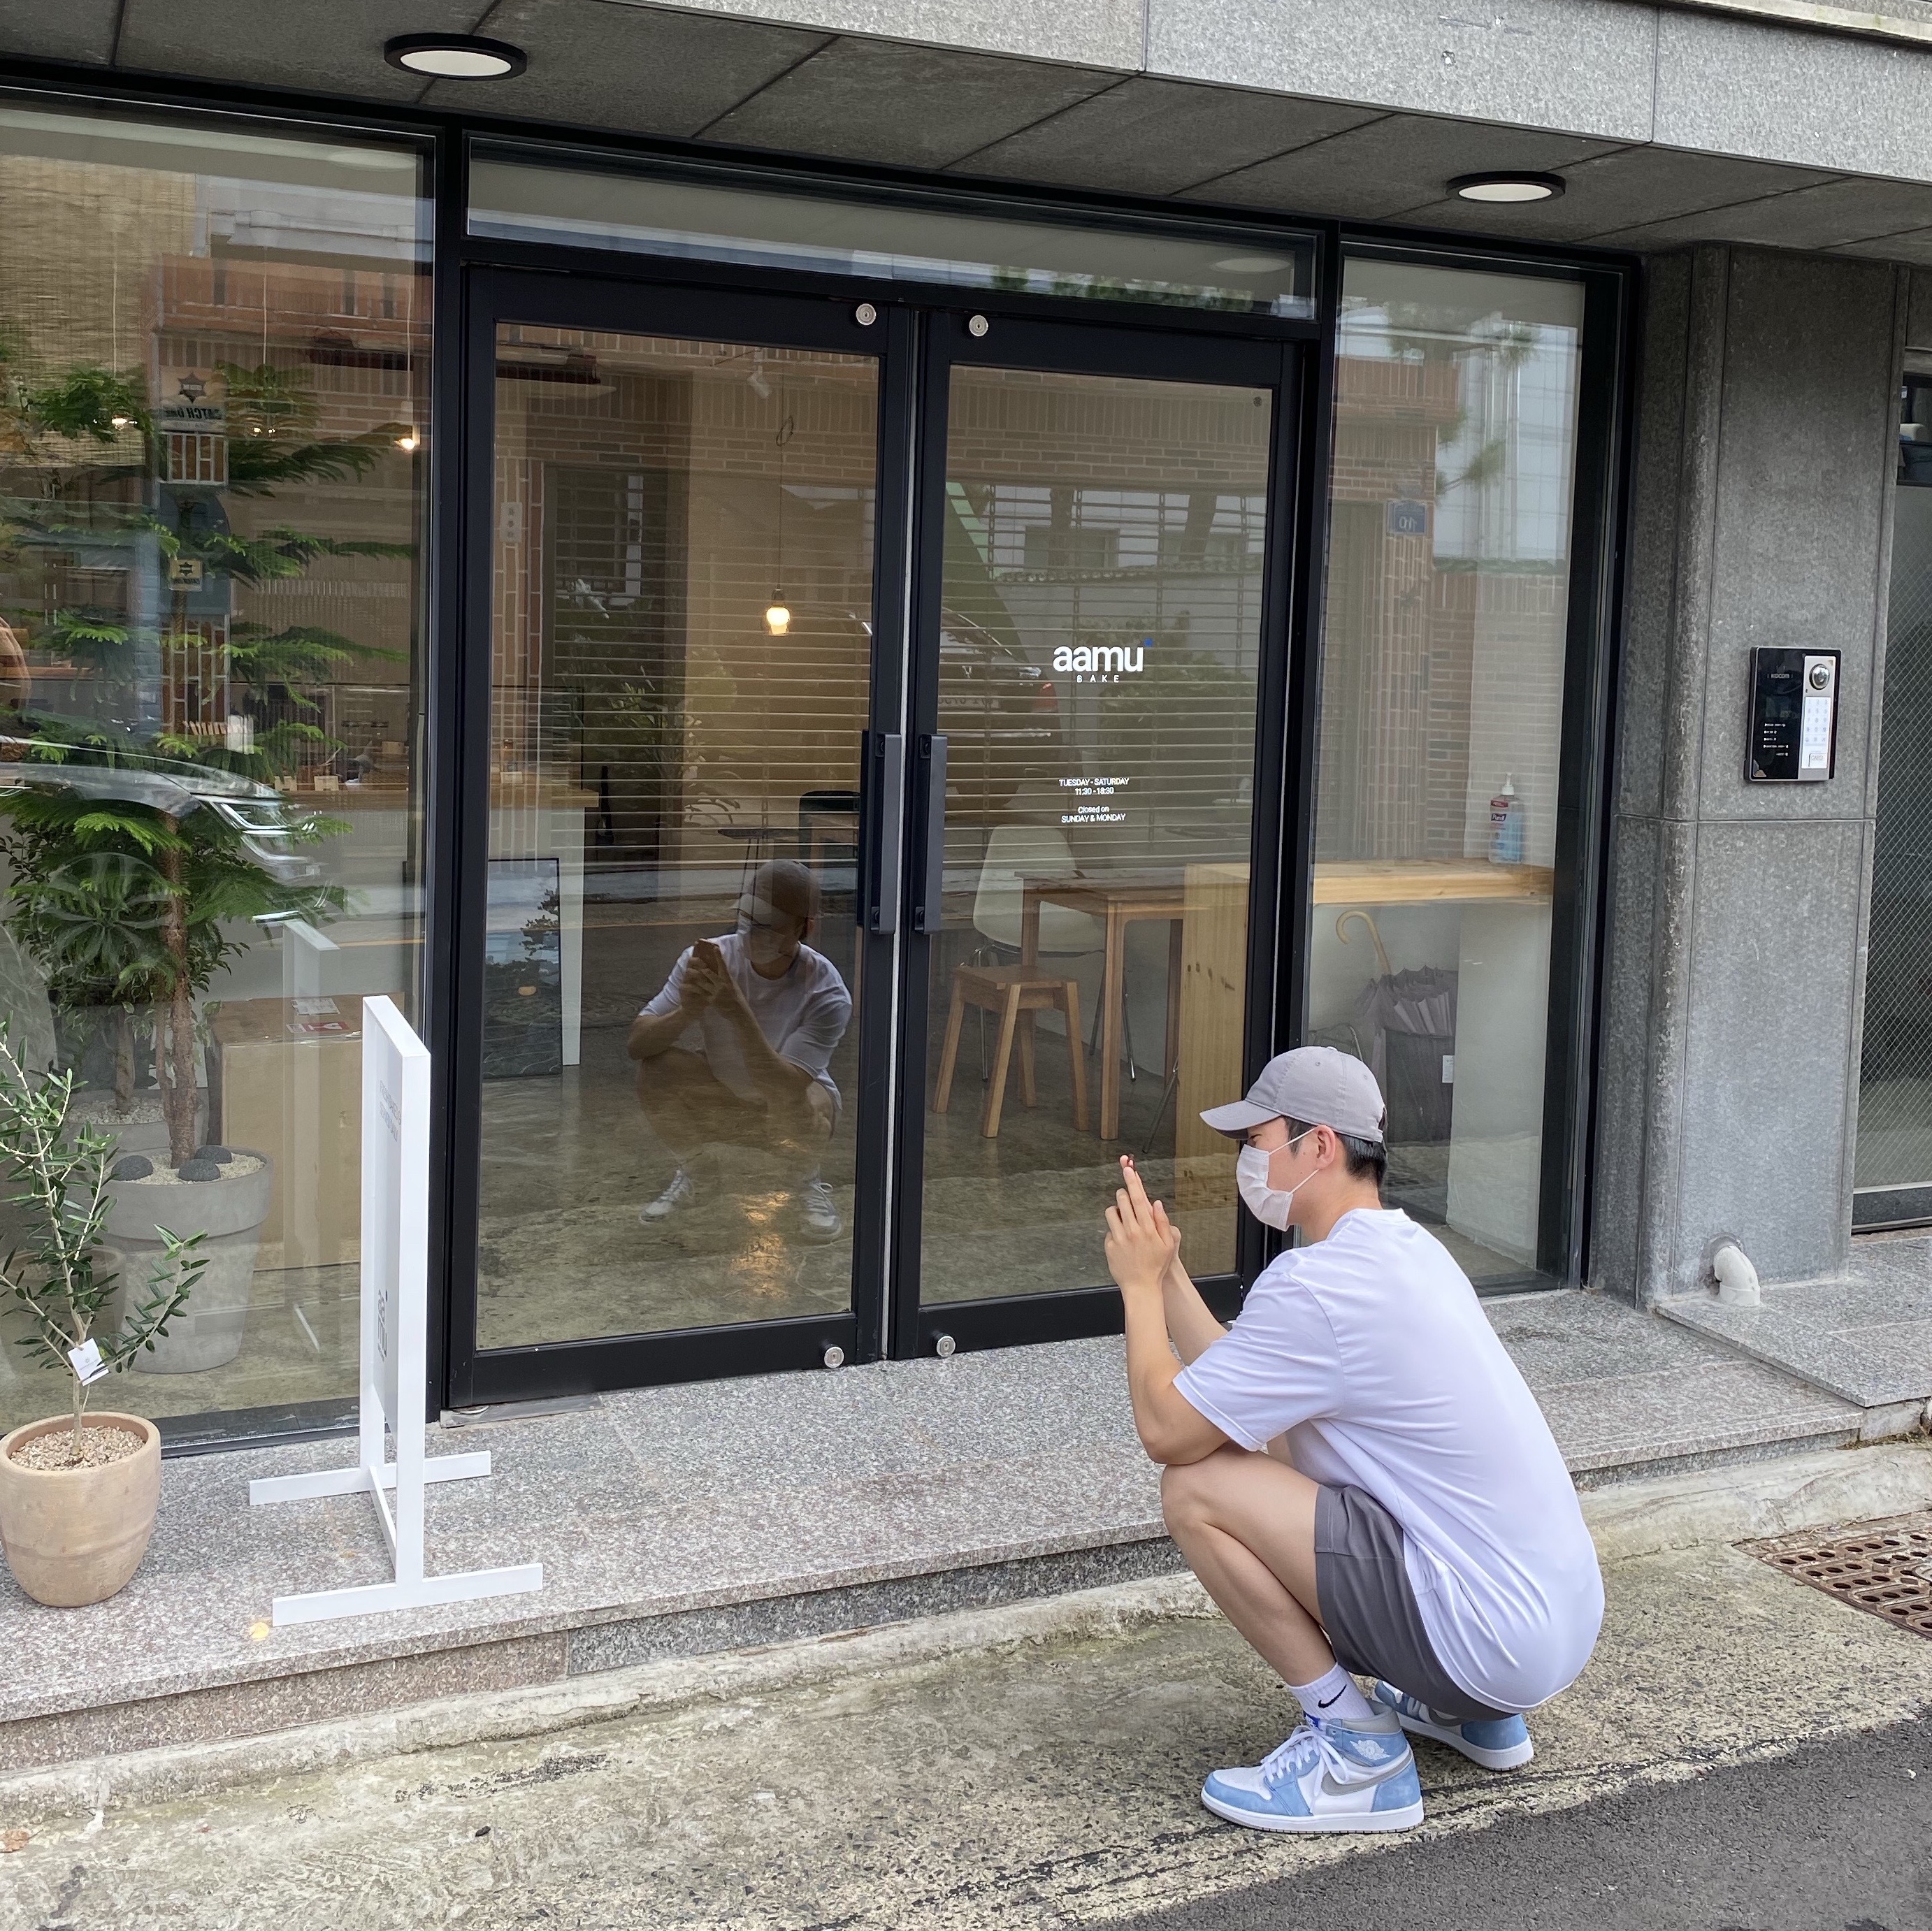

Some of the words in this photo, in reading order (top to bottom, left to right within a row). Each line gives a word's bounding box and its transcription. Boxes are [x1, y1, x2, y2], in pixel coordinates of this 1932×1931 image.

[1053, 646, 1144, 672] aamu
[1076, 674, 1120, 683] BAKE
[1059, 778, 1090, 786] TUESDAY
[1094, 777, 1129, 786] SATURDAY
[1077, 805, 1100, 813] Closed
